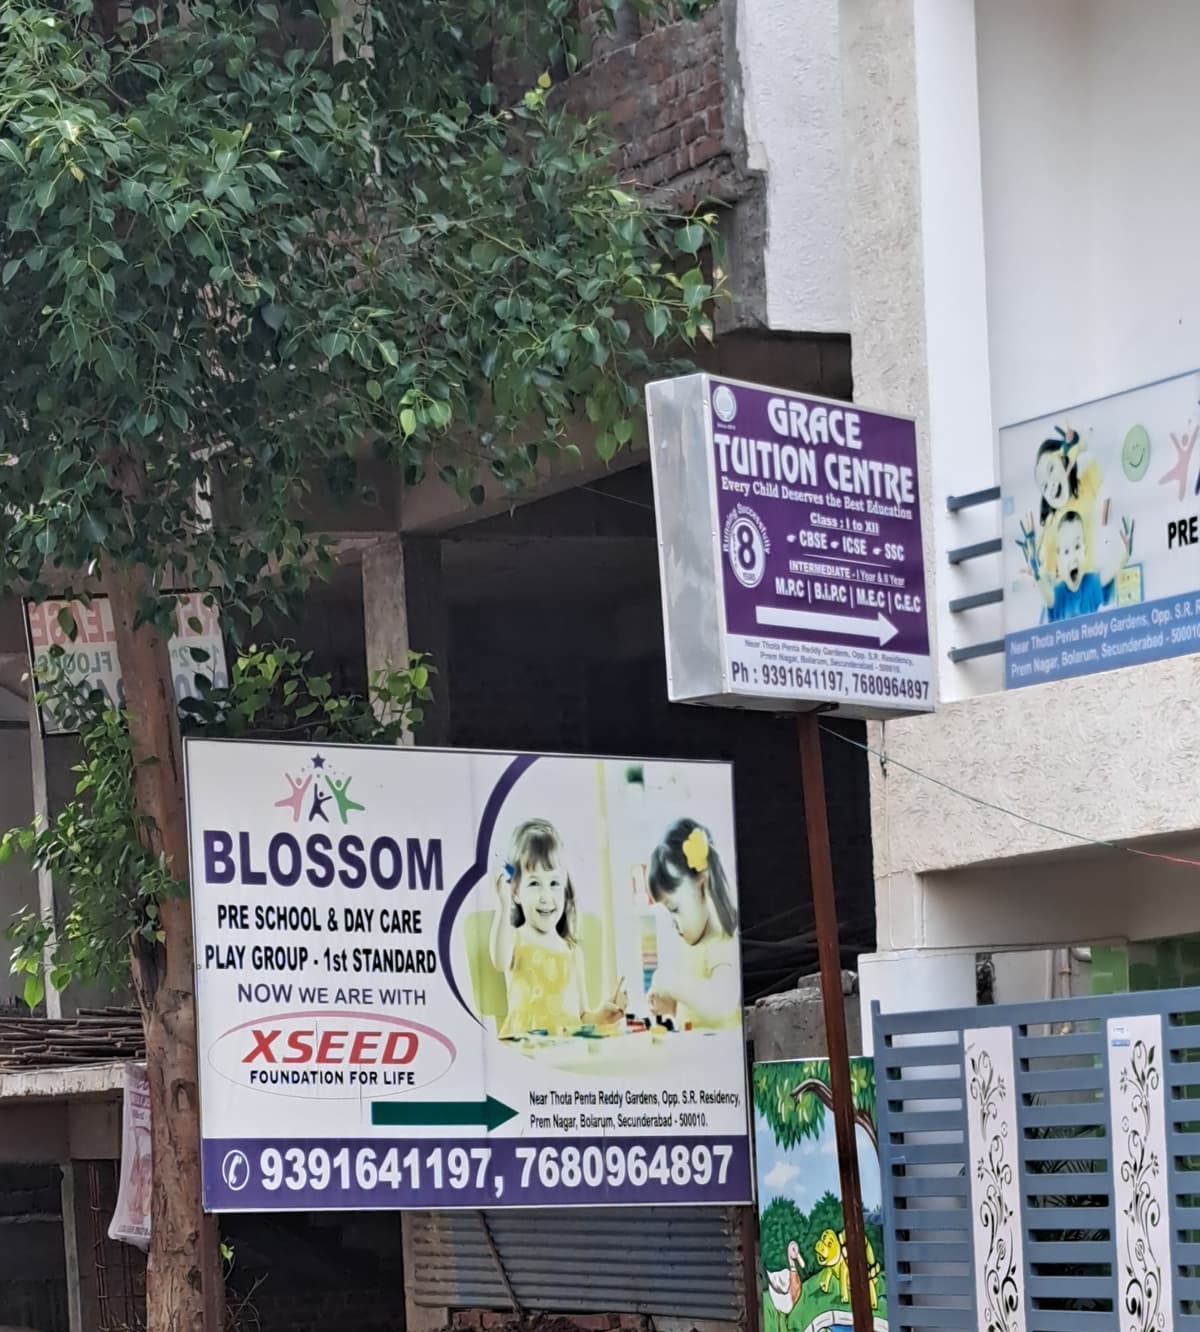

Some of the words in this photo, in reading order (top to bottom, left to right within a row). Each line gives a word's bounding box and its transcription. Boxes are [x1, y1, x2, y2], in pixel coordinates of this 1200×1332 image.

[768, 398, 862, 450] GRACE
[714, 433, 818, 486] TUITION
[824, 453, 915, 504] CENTRE
[722, 476, 750, 496] Every
[753, 482, 779, 499] Child
[781, 486, 823, 504] Deserves
[826, 494, 842, 507] the
[844, 497, 865, 512] Best
[867, 501, 912, 519] Education
[810, 512, 838, 528] Class
[852, 519, 863, 531] to
[865, 521, 880, 534] XII
[1168, 516, 1198, 550] PRE
[736, 524, 756, 571] 8
[800, 530, 828, 550] CBSE
[842, 536, 868, 556] ICSE
[884, 544, 904, 562] SSC
[789, 560, 850, 578] INTERMEDIATE
[775, 577, 804, 598] M.P.C
[856, 588, 886, 608] M.E.C
[894, 592, 921, 613] C.E.C
[1010, 641, 1030, 656] Near
[1056, 630, 1080, 644] Penta
[1081, 622, 1108, 639] Reddy
[1174, 601, 1194, 618] S.R.
[1011, 661, 1032, 678] Prem
[1101, 632, 1164, 658] Secunderabad
[732, 662, 748, 682] Ph
[762, 664, 848, 696] 9391641197,
[852, 673, 929, 700] 7680964897
[204, 830, 444, 890] BLOSSOM
[218, 904, 249, 930] PRE
[255, 906, 322, 932] SCHOOL
[328, 907, 338, 932] &
[344, 908, 374, 932] DAY
[380, 910, 422, 934] CARE
[205, 945, 246, 969] PLAY
[252, 946, 308, 970] GROUP
[324, 947, 348, 972] 1st
[352, 948, 436, 974] STANDARD
[238, 984, 292, 1004] NOW
[298, 987, 328, 1004] WE
[334, 988, 374, 1004] ARE
[378, 989, 426, 1006] WITH
[242, 1030, 419, 1064] XSEED
[250, 1070, 344, 1085] FOUNDATION
[350, 1071, 378, 1086] FOR
[384, 1072, 415, 1086] LIFE
[529, 1090, 548, 1106] Near
[550, 1090, 572, 1106] Thota
[574, 1091, 596, 1106] Penta
[599, 1090, 623, 1108] Reddy
[625, 1090, 660, 1107] Gardens,
[662, 1090, 680, 1107] Opp.
[682, 1090, 697, 1105] S.R.
[700, 1090, 740, 1108] Residency,
[530, 1114, 550, 1128] Prem
[553, 1114, 578, 1132] Nagar,
[580, 1113, 615, 1130] Bolarum,
[618, 1112, 672, 1128] Secunderabad
[680, 1112, 708, 1127] 500010.
[260, 1148, 503, 1198] 9391641197,
[515, 1144, 734, 1188] 7680964897
